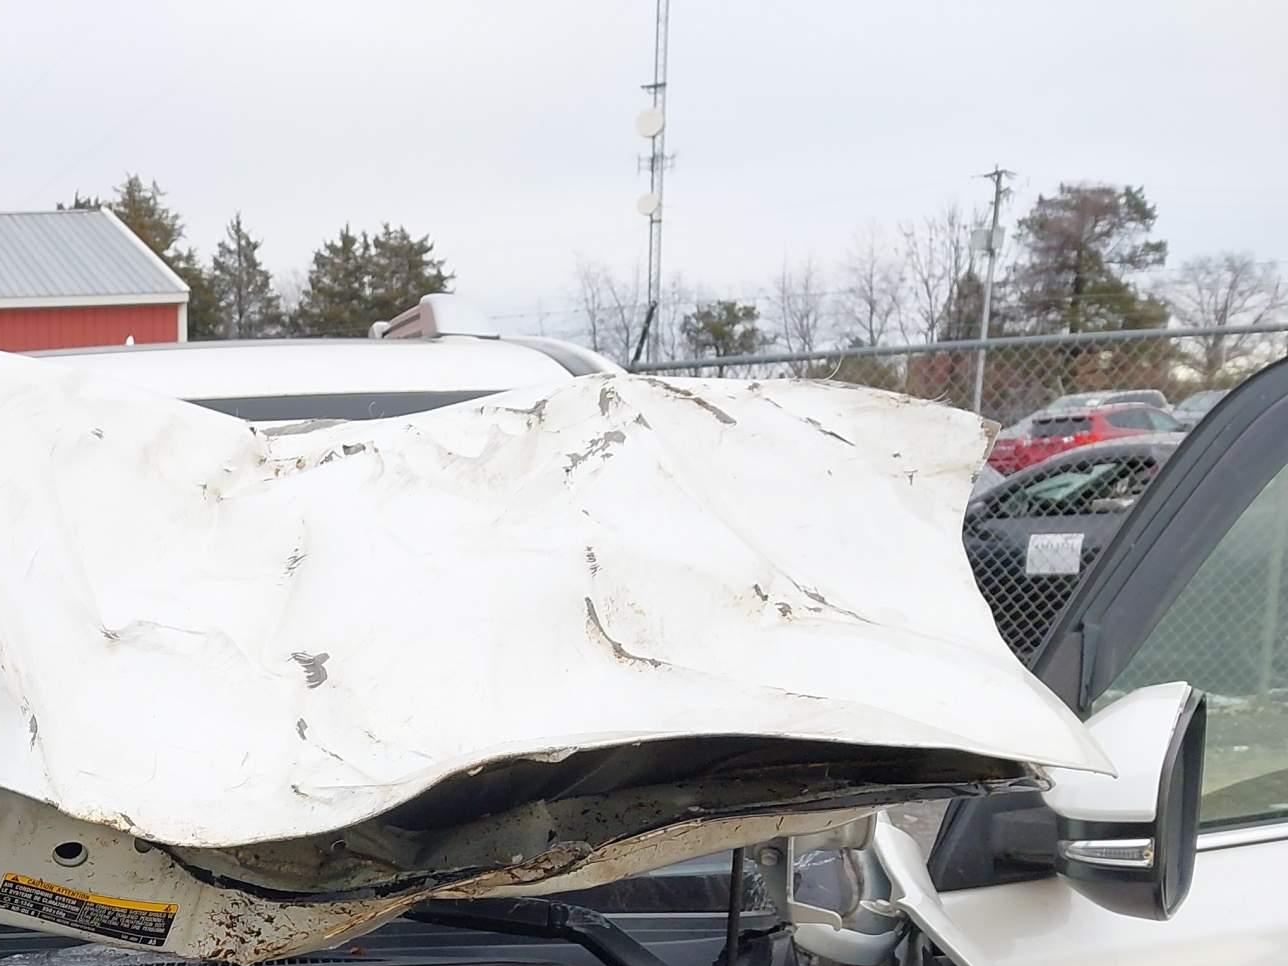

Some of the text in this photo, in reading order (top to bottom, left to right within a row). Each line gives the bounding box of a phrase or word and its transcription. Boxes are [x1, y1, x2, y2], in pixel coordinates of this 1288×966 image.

[15, 884, 53, 899] CONDITIONING
[27, 879, 89, 900] CAUTION ATTENTION
